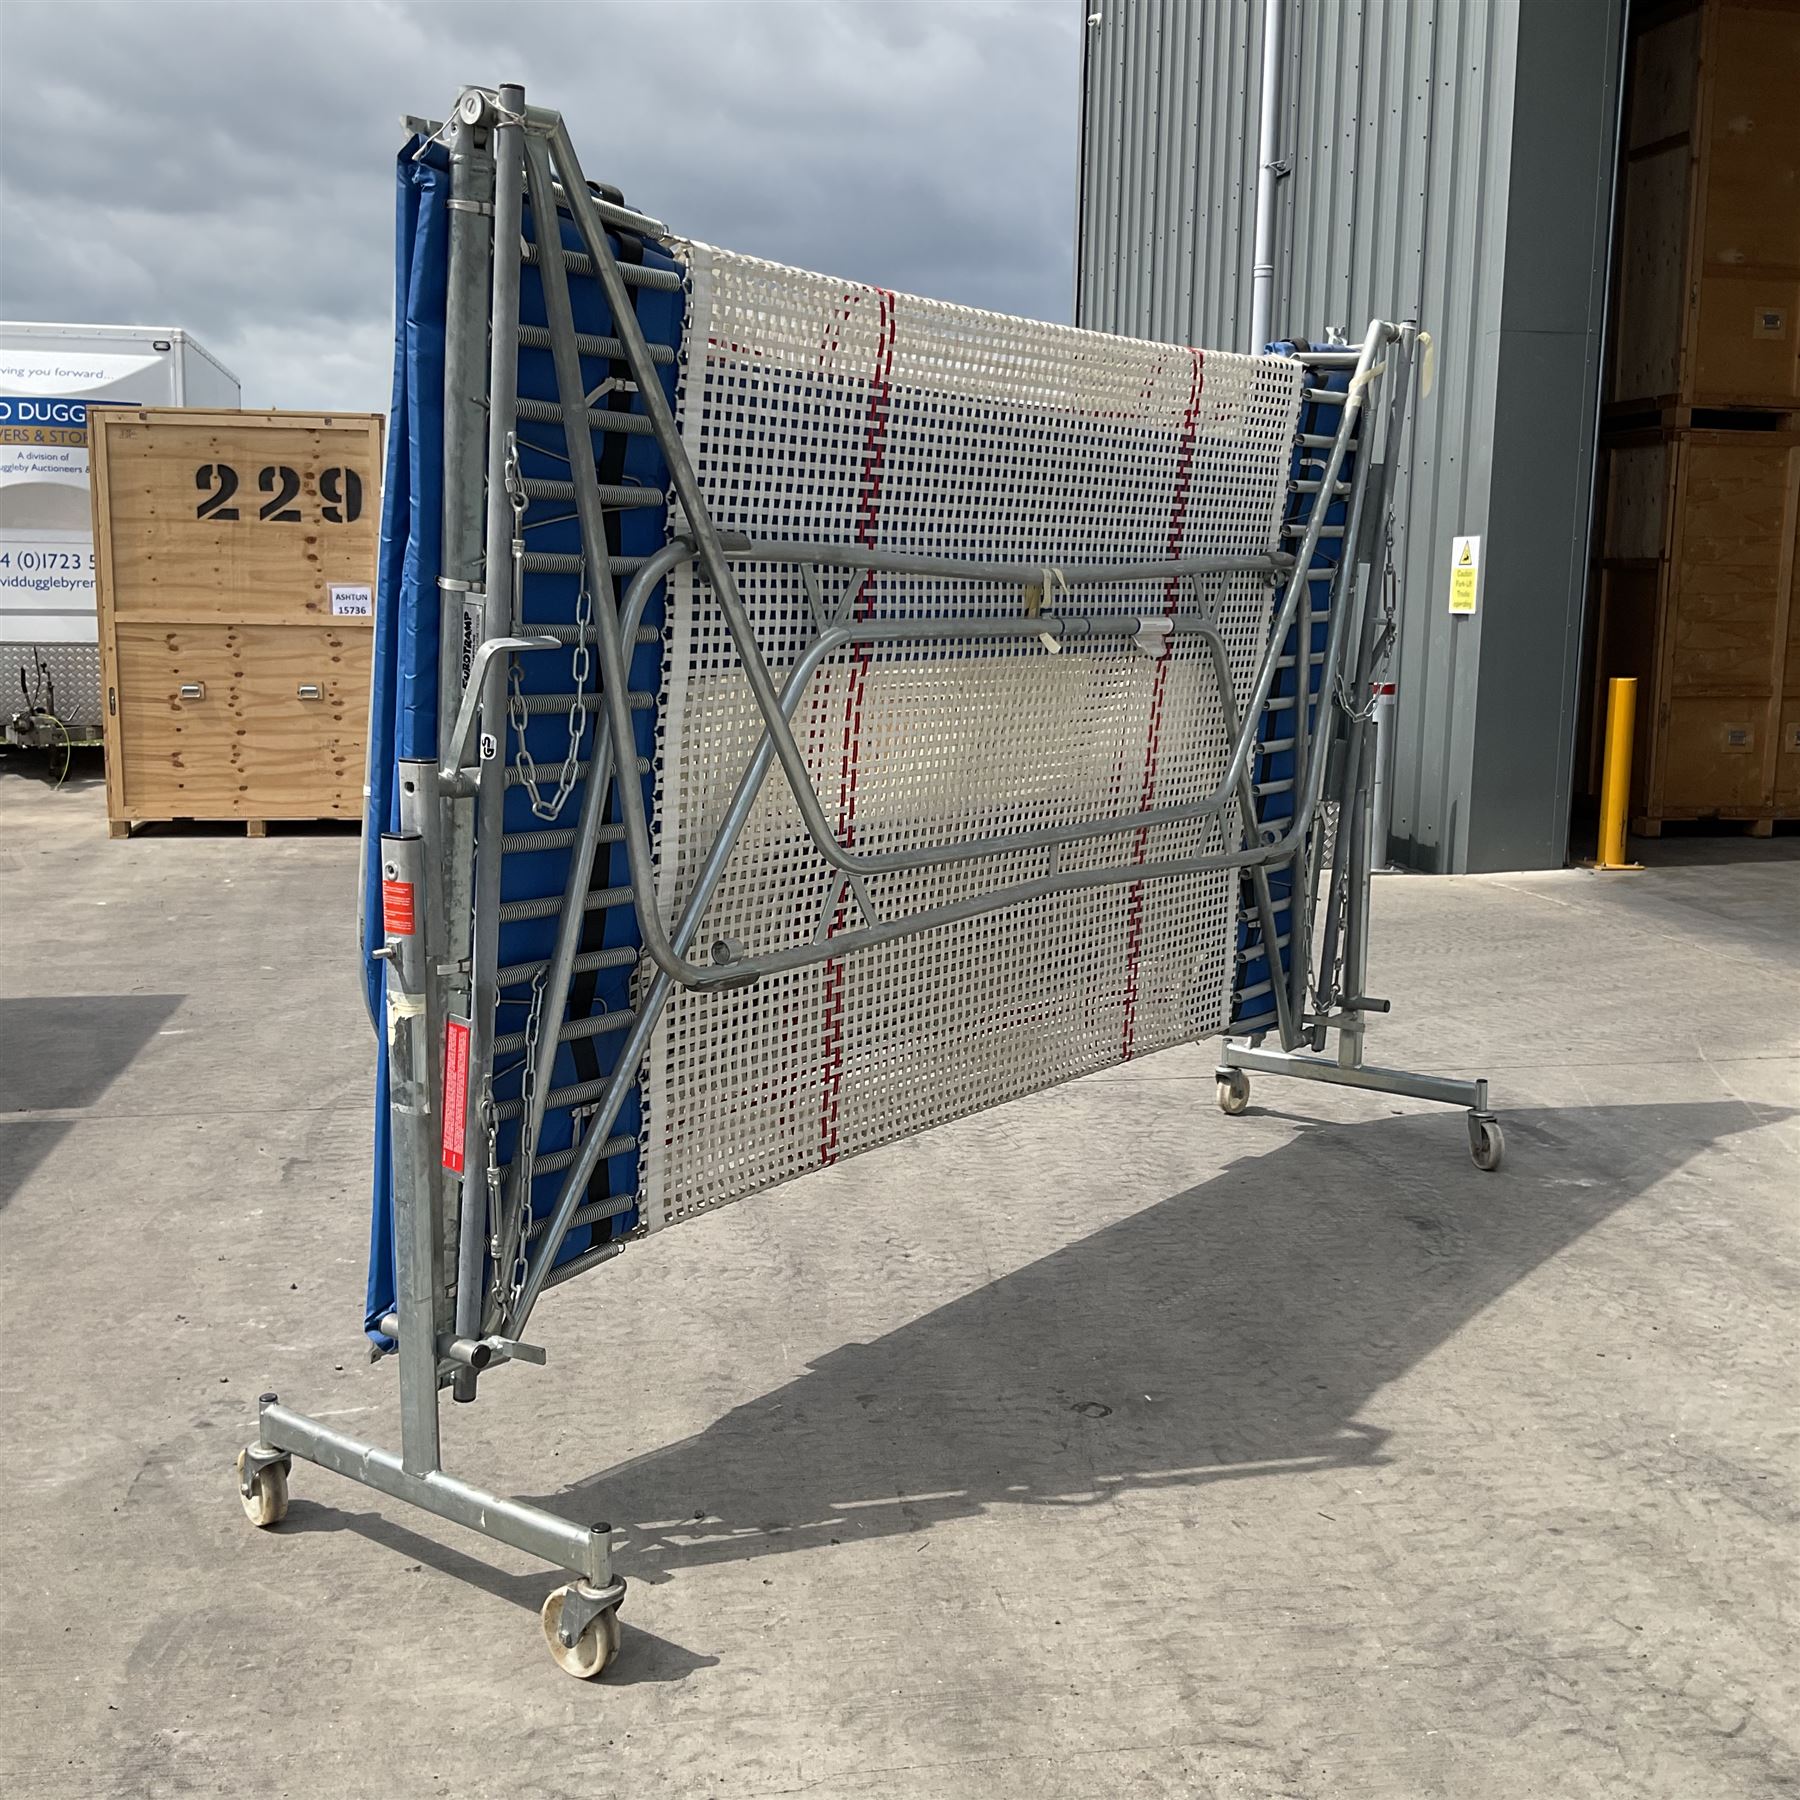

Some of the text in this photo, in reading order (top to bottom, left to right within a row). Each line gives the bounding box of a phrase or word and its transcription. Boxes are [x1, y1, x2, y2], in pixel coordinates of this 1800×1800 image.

[26, 368, 51, 377] you
[34, 430, 44, 442] &
[17, 451, 69, 461] A division of
[31, 464, 82, 473] Auctioneers
[195, 463, 363, 523] 229
[338, 606, 367, 615] 15736
[462, 611, 473, 690] EUROTRAMP
